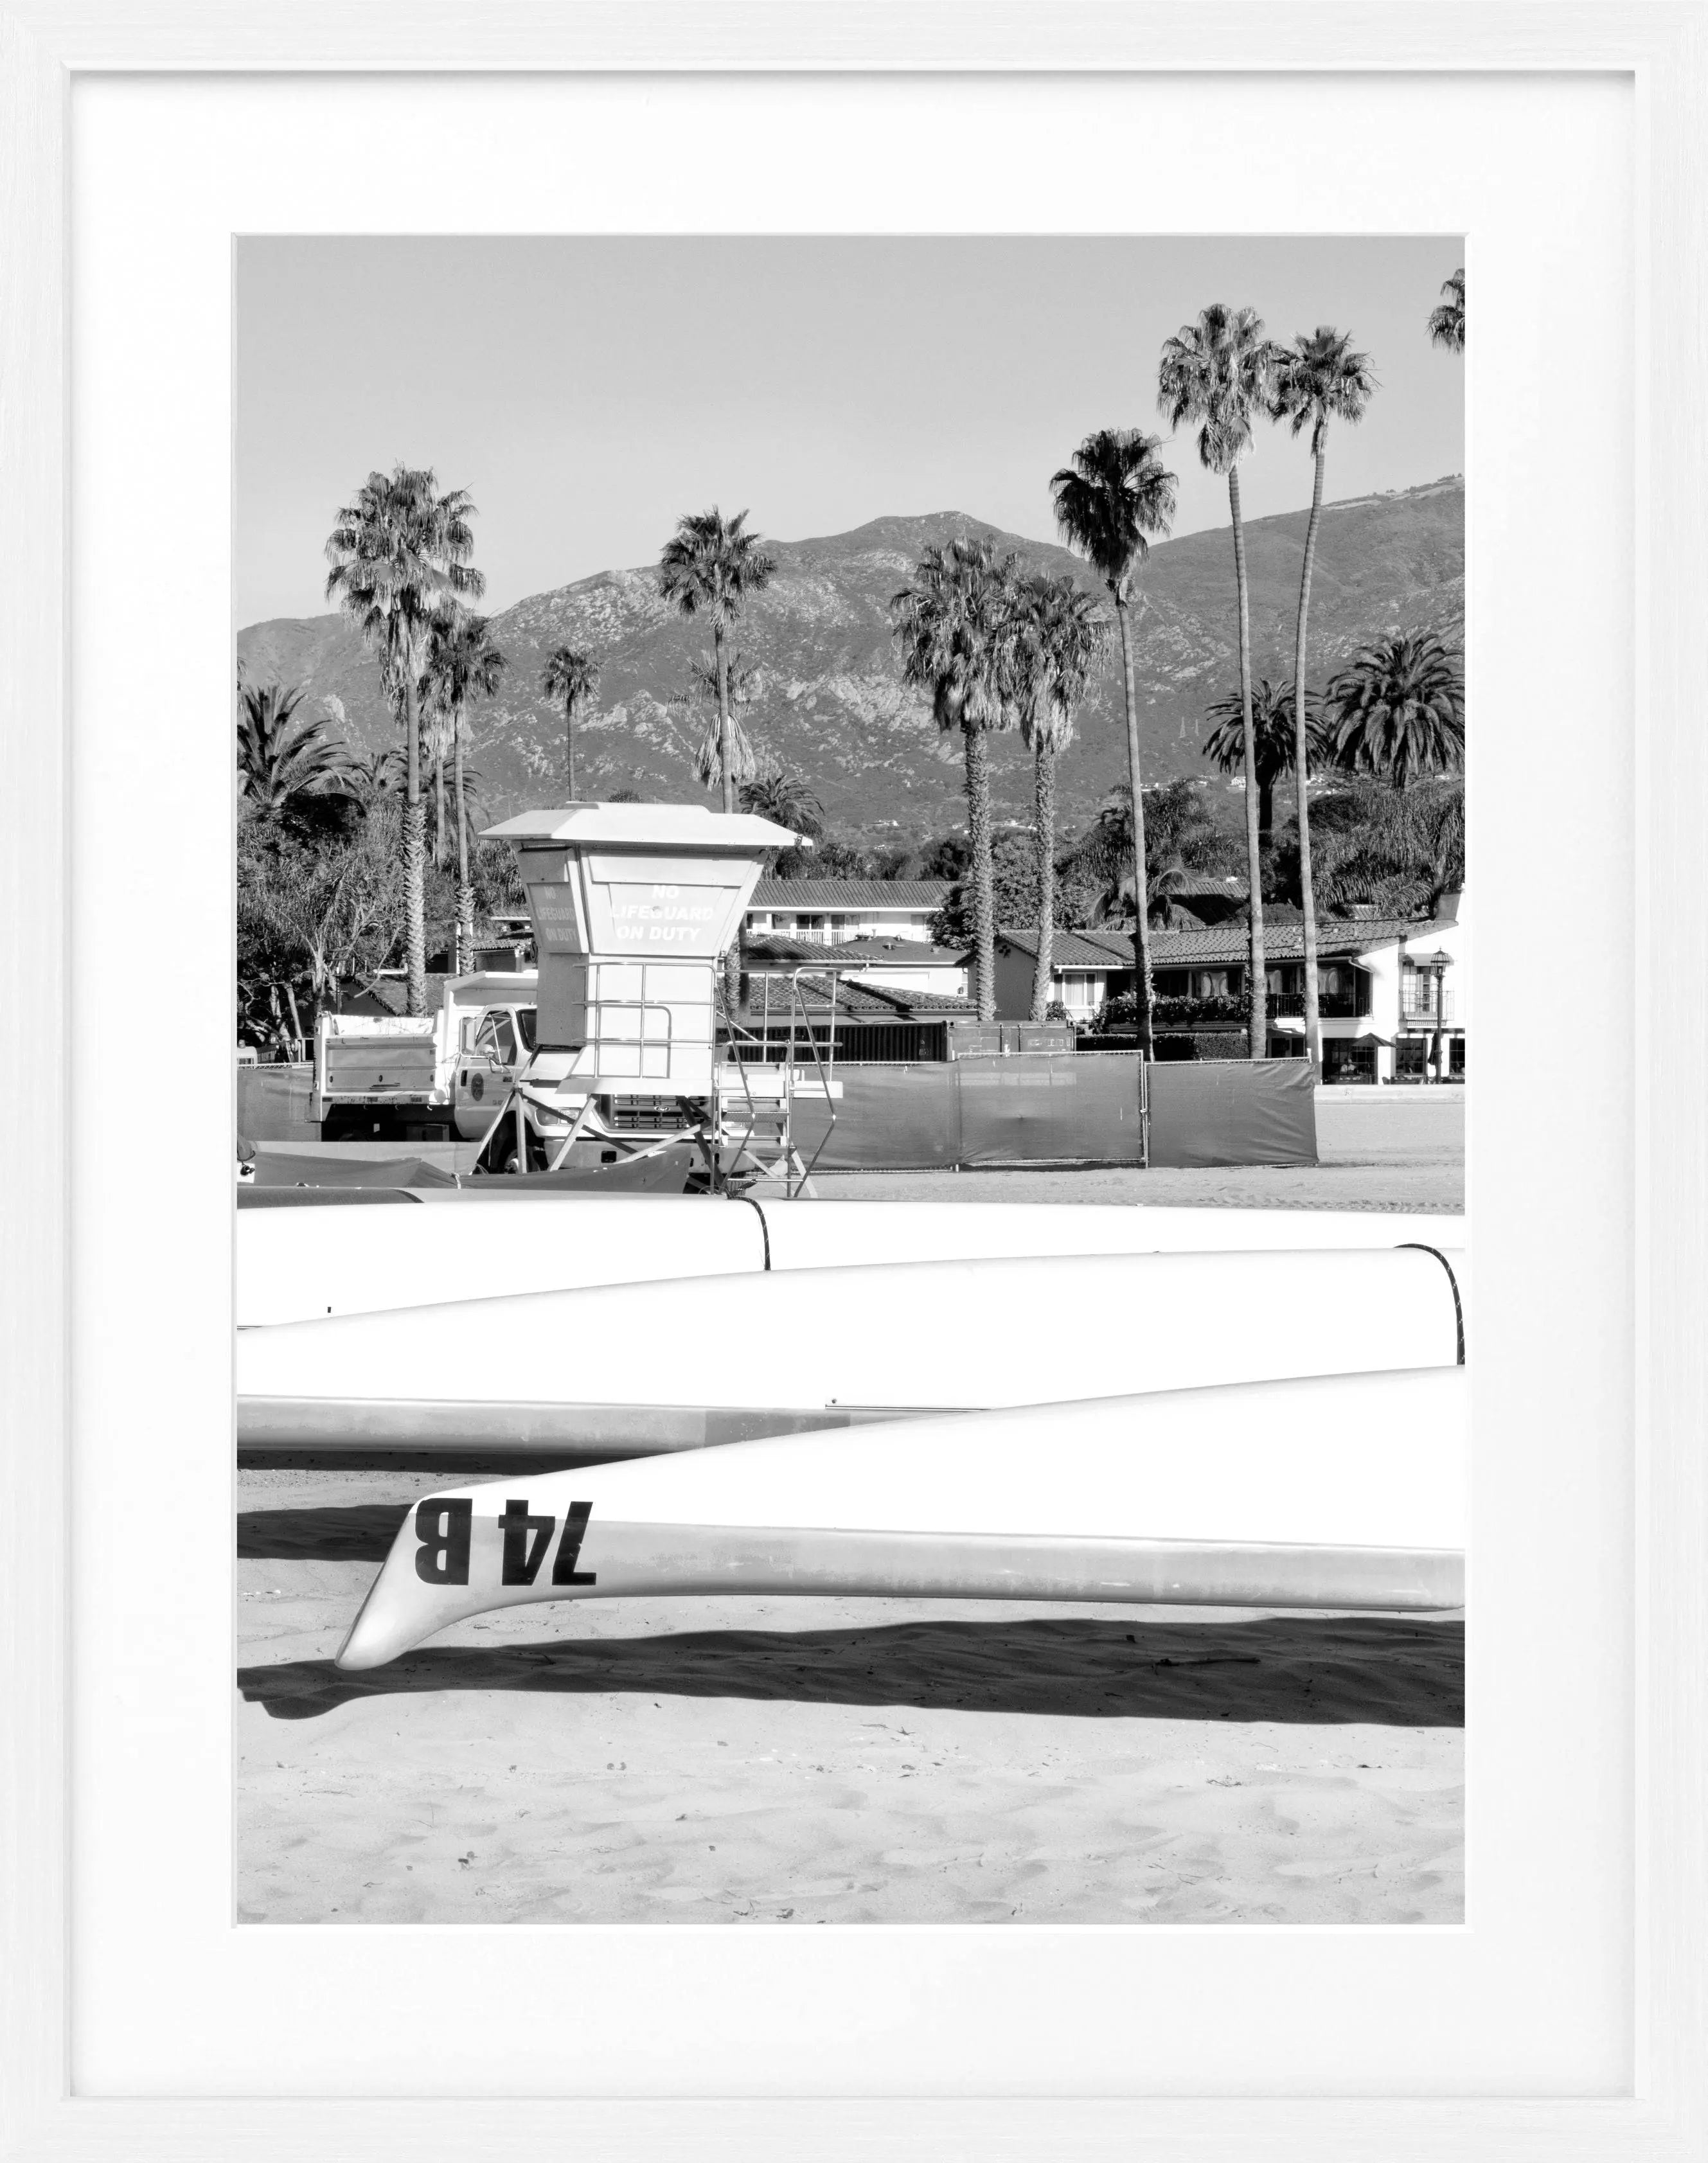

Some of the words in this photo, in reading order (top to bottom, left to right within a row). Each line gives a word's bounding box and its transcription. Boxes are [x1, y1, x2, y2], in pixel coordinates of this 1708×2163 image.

[544, 886, 556, 899] NO
[653, 885, 679, 899] NO
[536, 907, 575, 920] LIFEGUARD
[610, 905, 714, 920] LIFEGUARD
[546, 928, 557, 941] ON
[557, 928, 577, 941] DUTY
[617, 926, 644, 939] ON
[649, 927, 702, 940] DUTY
[416, 1499, 472, 1585] B
[499, 1500, 596, 1586] 74
